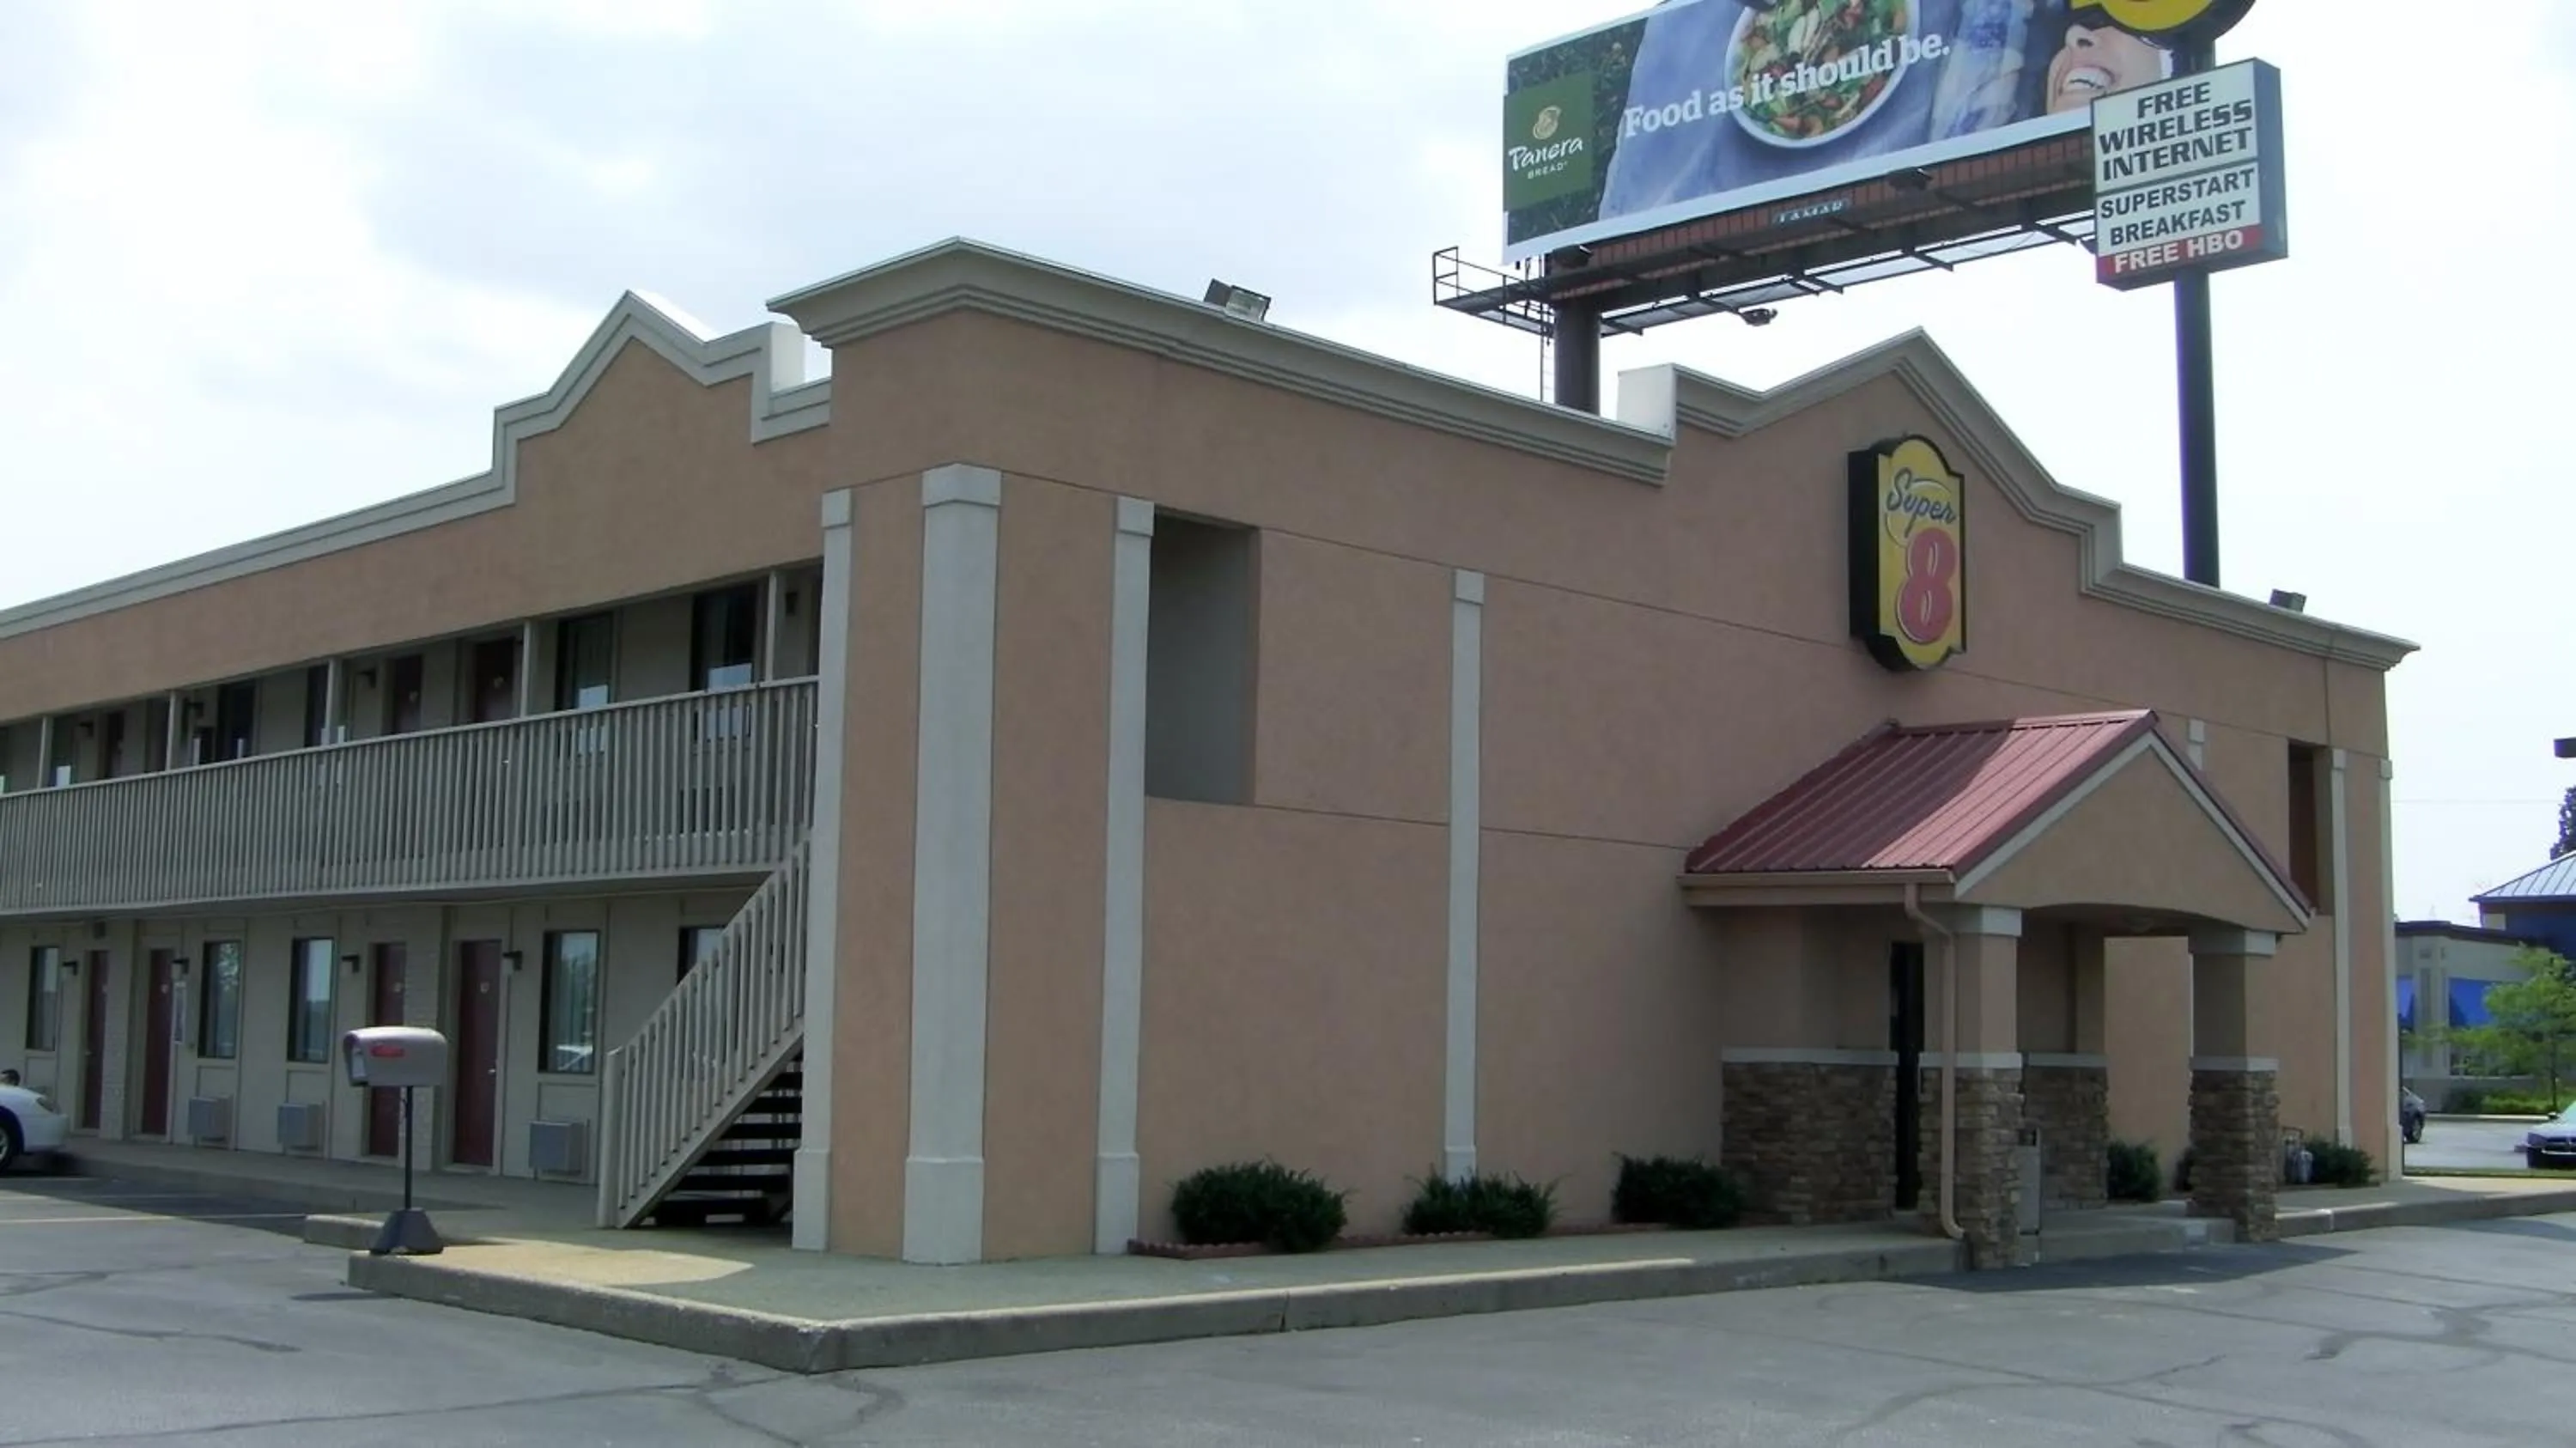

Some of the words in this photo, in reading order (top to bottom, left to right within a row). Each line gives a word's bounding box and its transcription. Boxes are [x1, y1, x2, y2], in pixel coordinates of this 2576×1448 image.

[1622, 90, 1703, 138] Food
[1709, 84, 1744, 115] as
[1750, 72, 1775, 105] it
[1777, 40, 1893, 96] should
[1899, 33, 1951, 65] be.
[2137, 82, 2211, 119] FREE
[2099, 99, 2253, 155] WIRELESS
[1508, 137, 1583, 172] Panera
[2103, 127, 2253, 181] INTERNET
[2100, 167, 2256, 219] SUPERSTART
[2111, 200, 2246, 246] BREAKFAST
[2114, 241, 2179, 274] FREE
[2187, 229, 2244, 259] HBO
[1886, 466, 1957, 538] Super
[1895, 526, 1957, 645] 8
